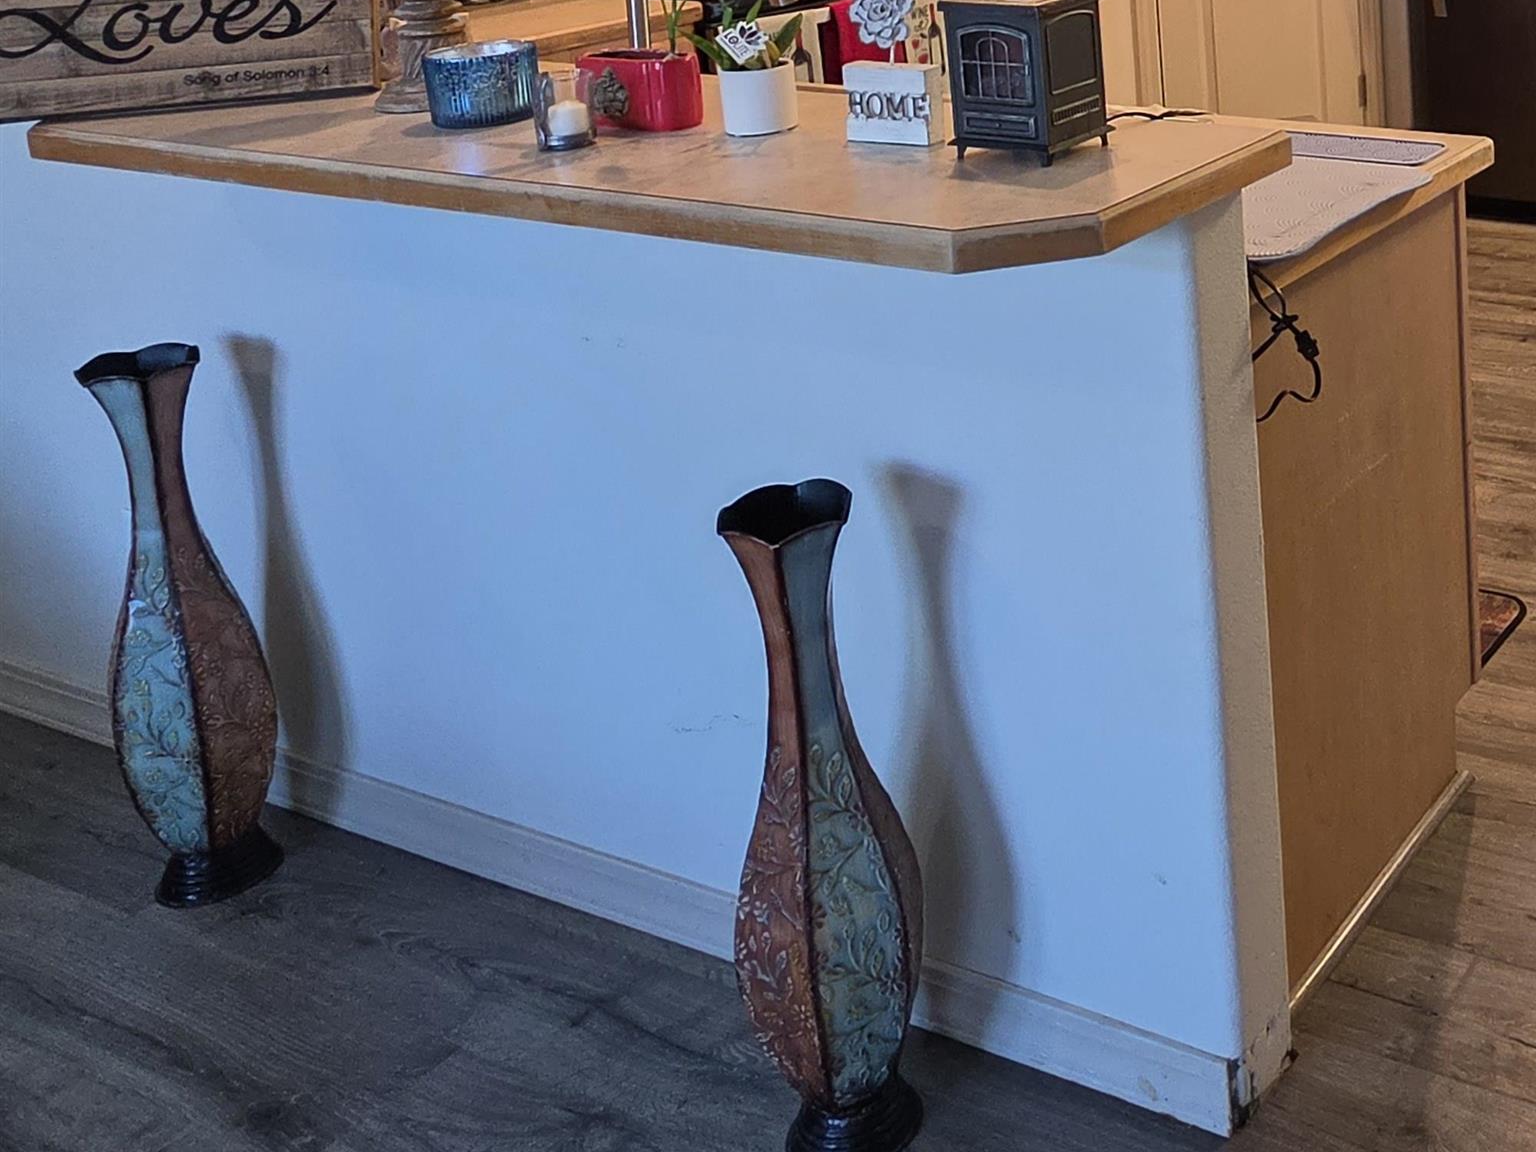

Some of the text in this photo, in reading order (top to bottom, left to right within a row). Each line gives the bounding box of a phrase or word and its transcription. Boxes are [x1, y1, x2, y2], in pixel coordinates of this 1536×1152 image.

[183, 71, 221, 87] Song
[225, 71, 239, 84] of
[243, 67, 305, 83] Solomon
[848, 91, 931, 122] HOME
